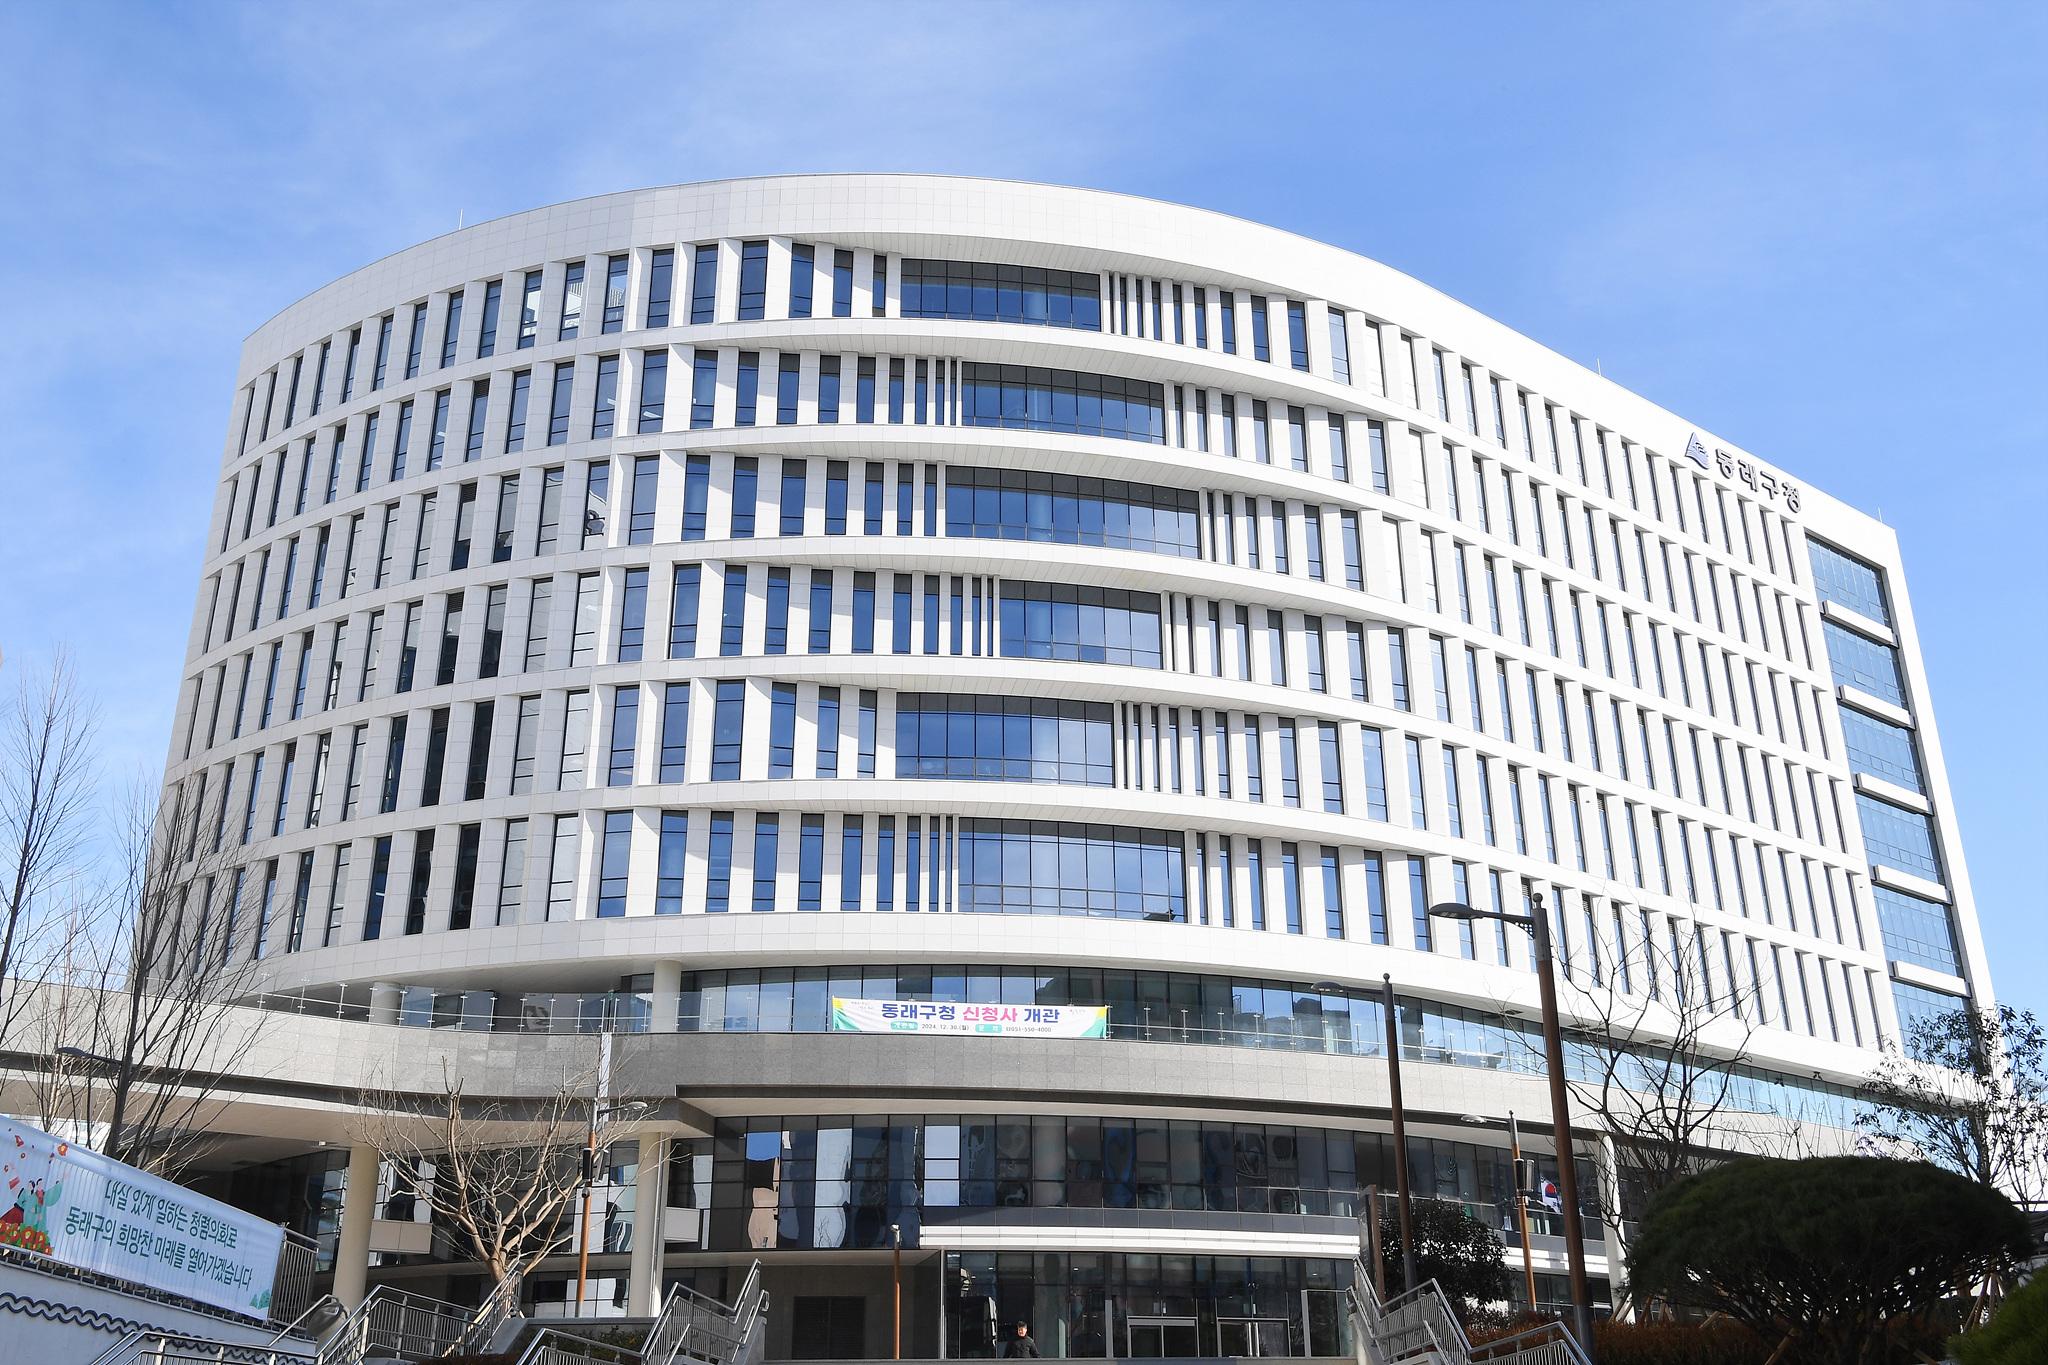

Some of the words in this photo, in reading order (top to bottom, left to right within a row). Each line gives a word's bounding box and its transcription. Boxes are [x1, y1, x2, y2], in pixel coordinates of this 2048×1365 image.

[1715, 448, 1801, 514] 동래구청
[881, 1003, 956, 1020] 동래구청
[963, 1006, 1018, 1023] 신청사
[1024, 1007, 1060, 1024] 개관
[105, 1179, 132, 1210] 내실
[131, 1189, 156, 1220] 있게
[156, 1199, 189, 1232] 일하는
[189, 1211, 239, 1250] 청렴의회로
[65, 1206, 117, 1247] 동래구의
[116, 1223, 153, 1258] 희망찬
[154, 1236, 187, 1269] 미래를
[187, 1247, 253, 1292] 열어가겠습니다
